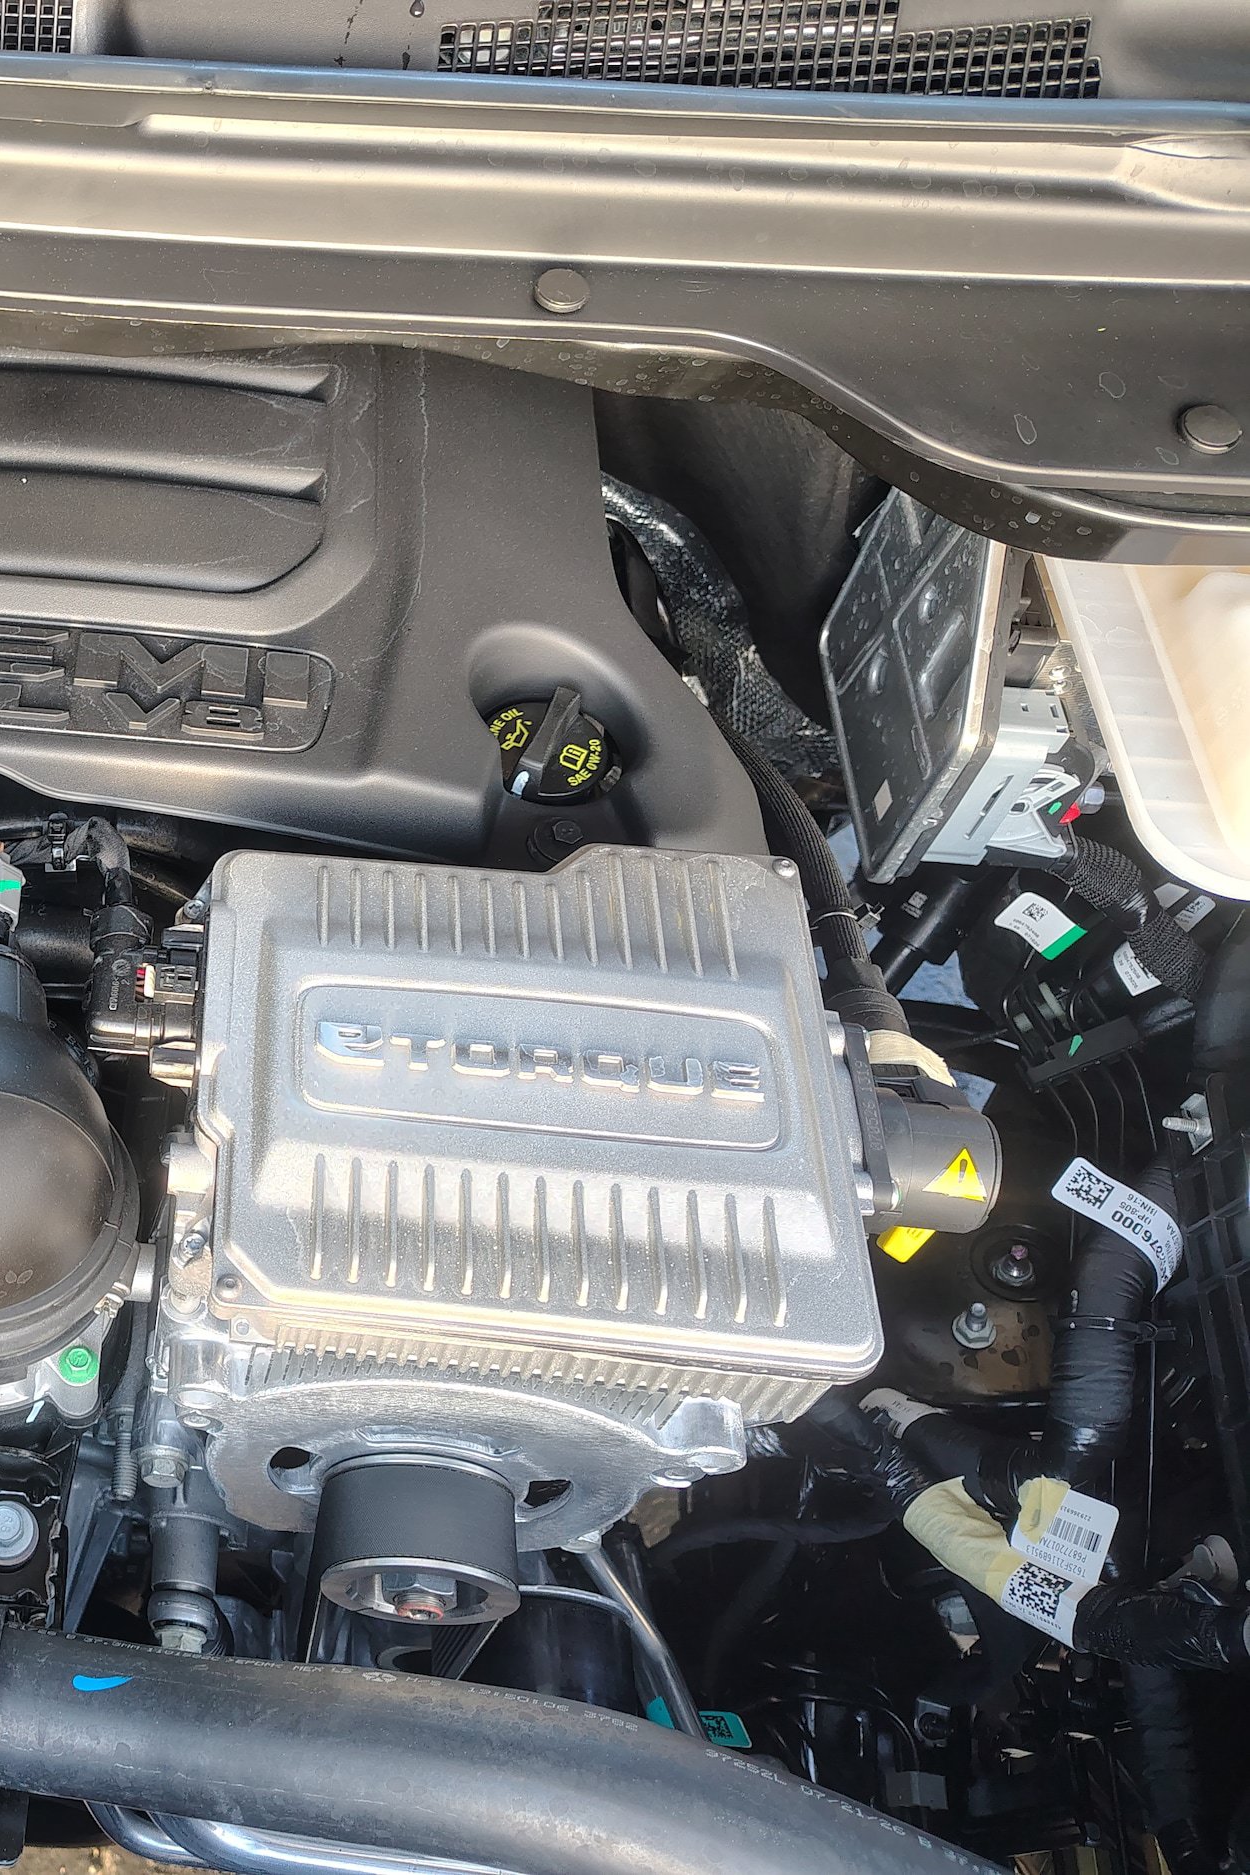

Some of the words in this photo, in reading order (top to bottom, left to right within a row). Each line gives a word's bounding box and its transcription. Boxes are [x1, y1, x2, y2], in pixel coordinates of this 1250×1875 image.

[104, 691, 265, 741] V8
[489, 719, 506, 736] NE
[500, 707, 524, 722] OIL
[566, 768, 592, 787] SAE
[586, 739, 602, 770] 0W-20
